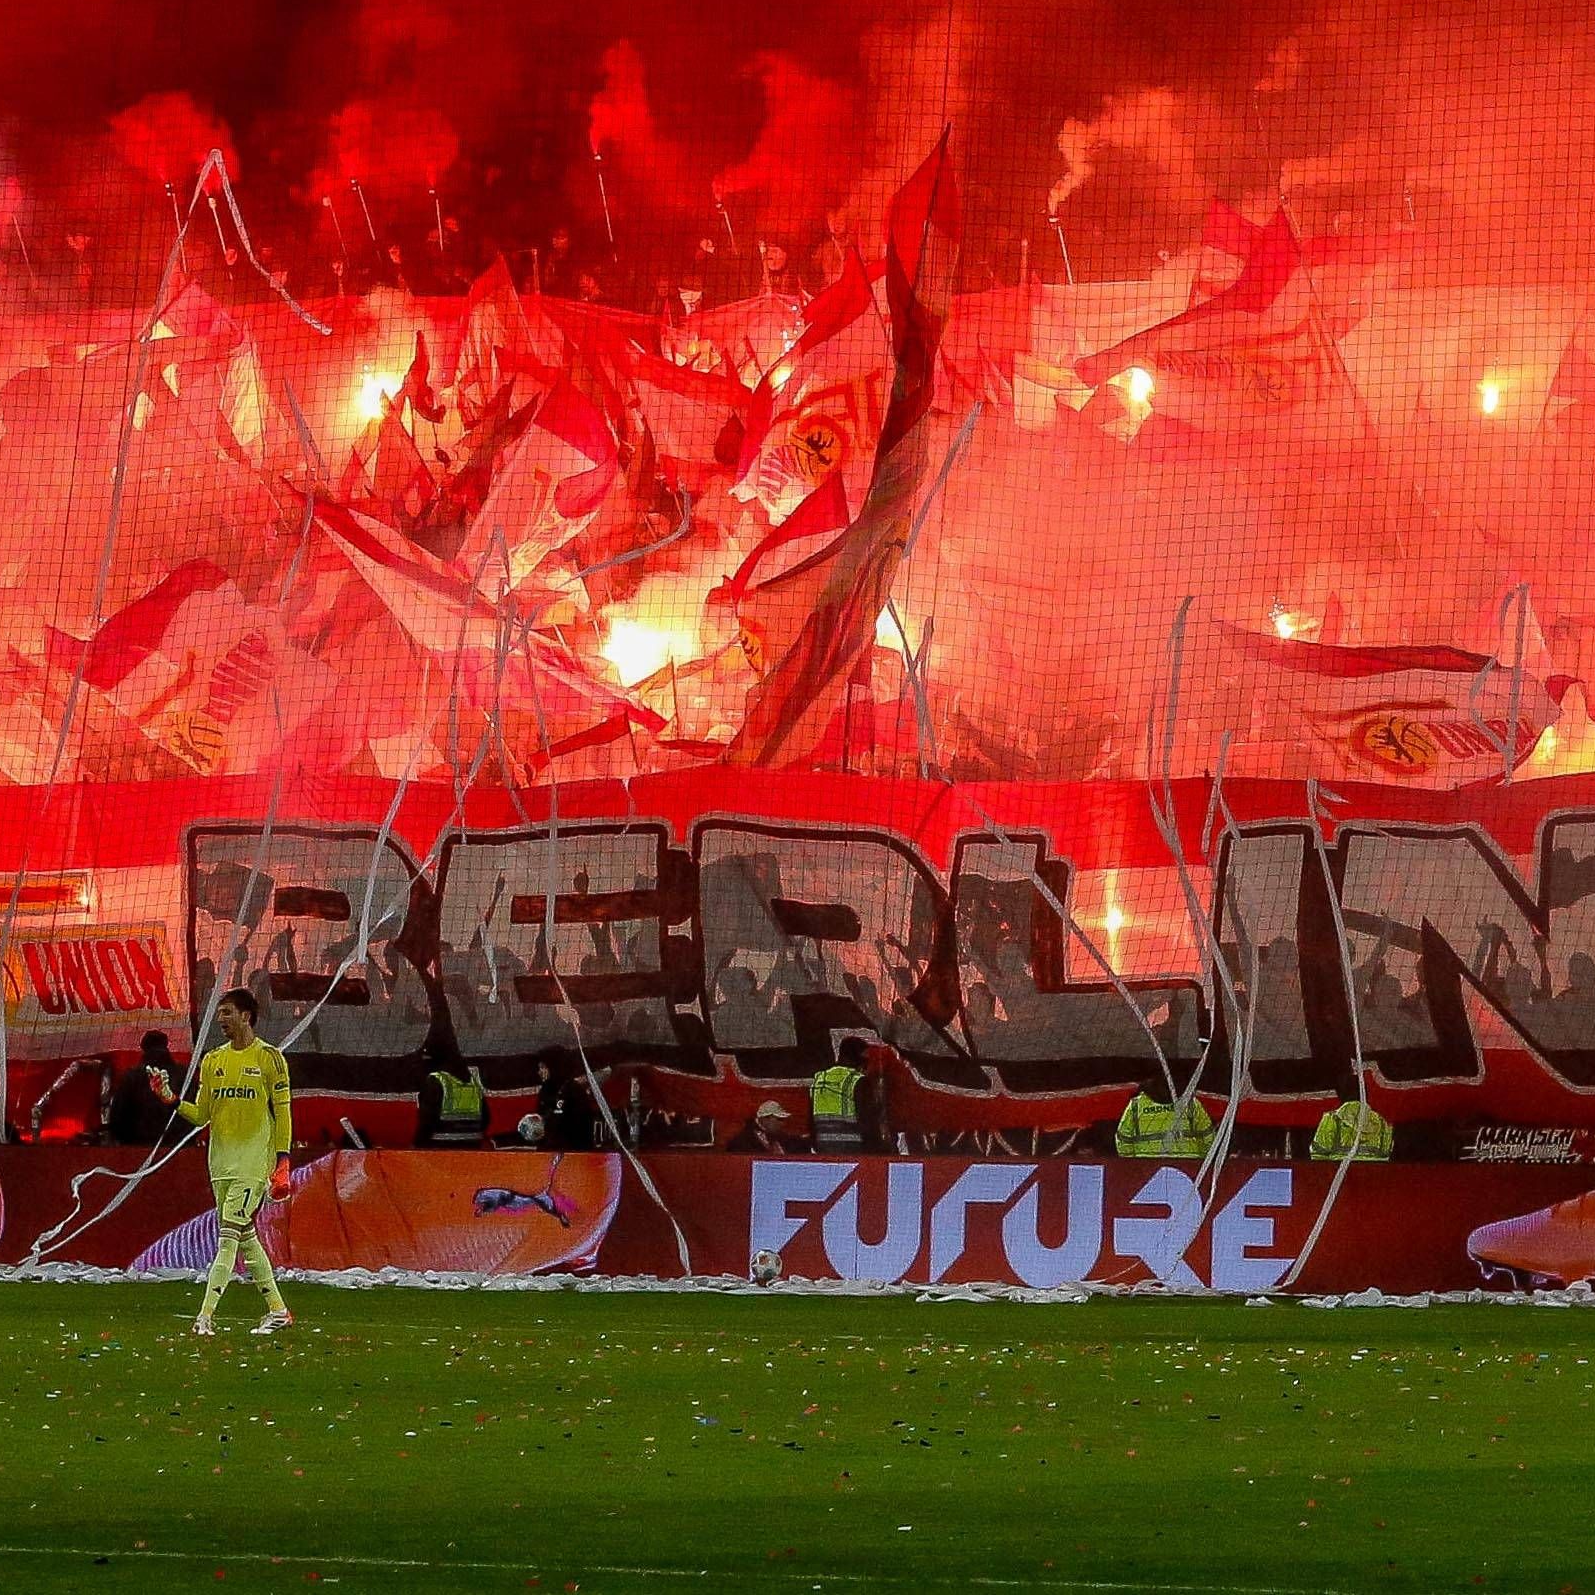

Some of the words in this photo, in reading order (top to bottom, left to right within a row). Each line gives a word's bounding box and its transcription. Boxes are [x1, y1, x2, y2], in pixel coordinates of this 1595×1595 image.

[20, 936, 175, 1016] UNION
[243, 1187, 252, 1209] 1
[749, 1160, 1296, 1291] FUTURE
